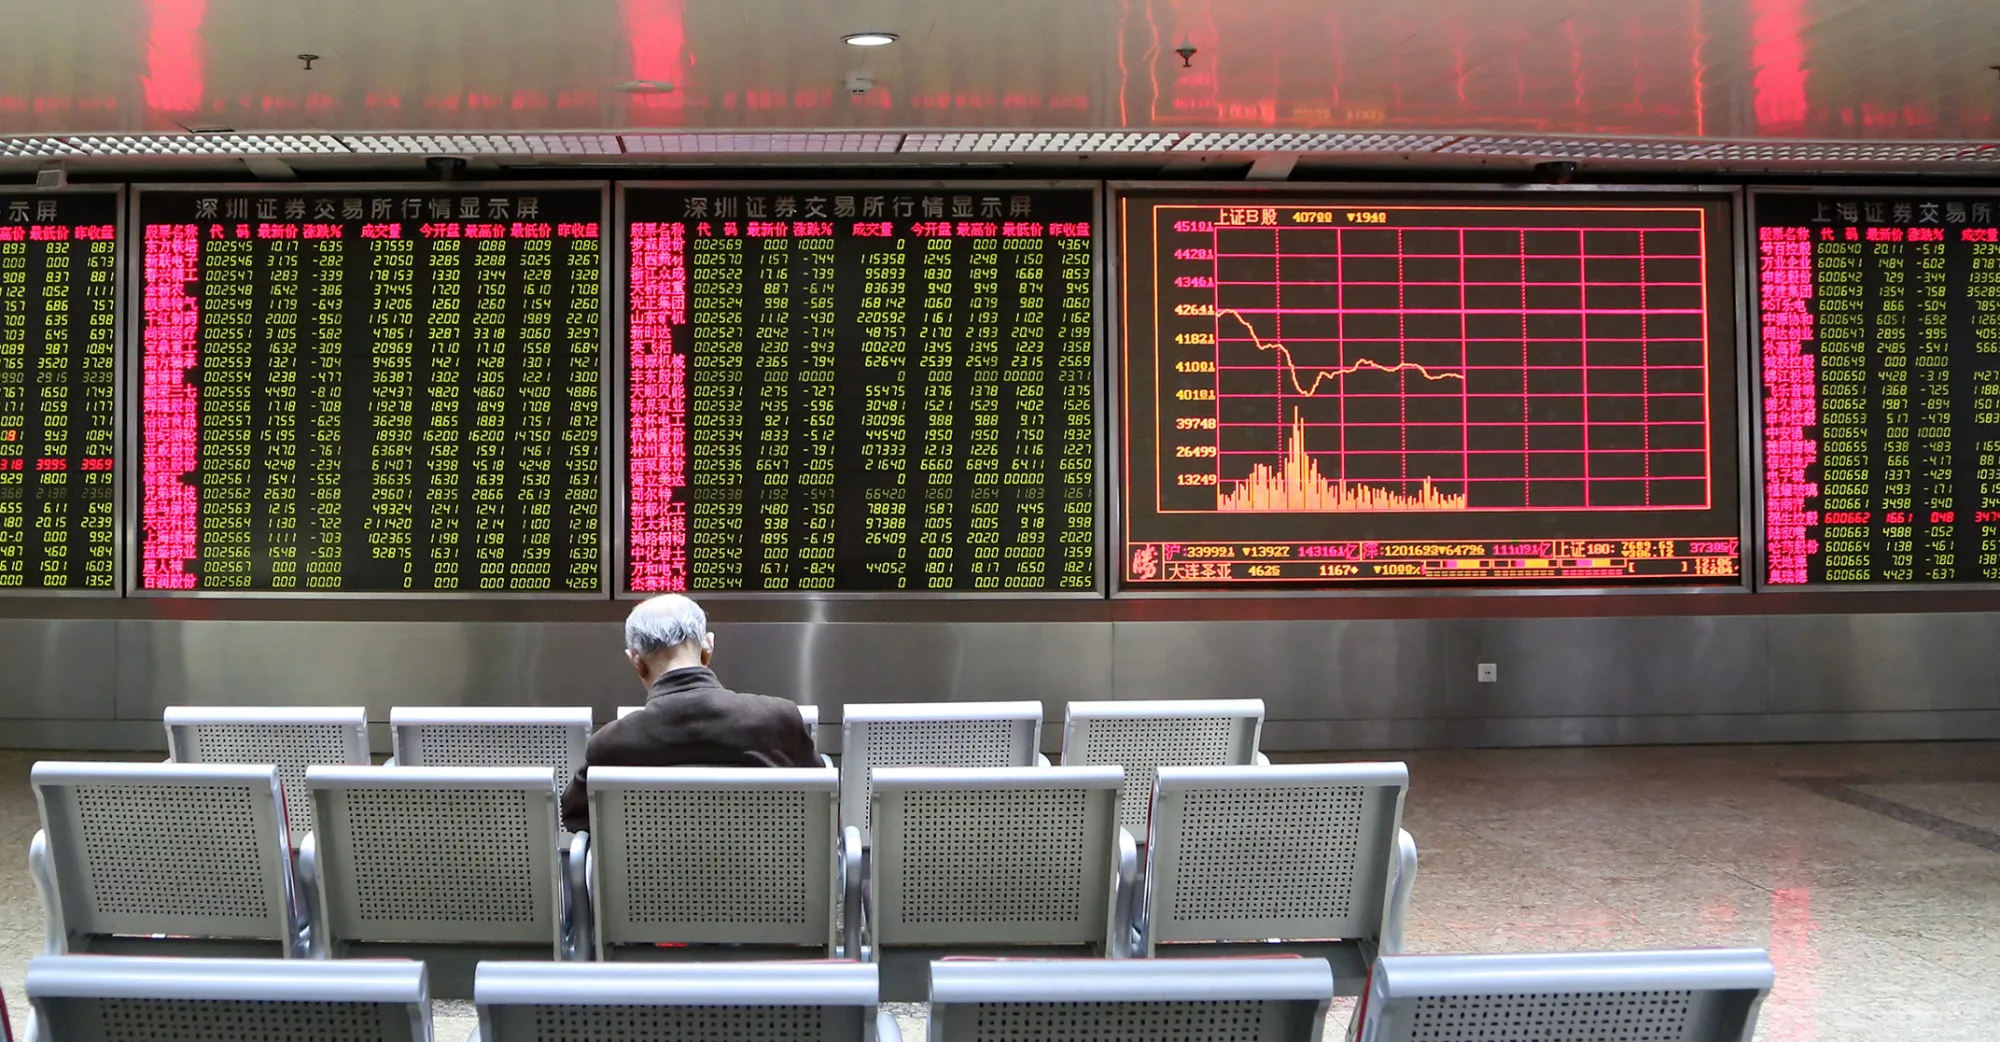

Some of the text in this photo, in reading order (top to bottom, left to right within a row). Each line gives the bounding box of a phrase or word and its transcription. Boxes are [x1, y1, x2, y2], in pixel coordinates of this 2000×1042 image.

[0, 201, 58, 221] 示屏
[195, 198, 540, 220] 深圳证券交易所行情显示屏
[683, 196, 1032, 218] 深圳证券交易所行情显示屏
[1812, 202, 2000, 223] 上海证券交易所
[0, 225, 114, 241] 高价 最低价 昨收盘
[145, 223, 599, 239] 股票名称 代码 最新价 涨跌% 成交量 今开盘 最高价 最低价 昨收盘
[630, 222, 1090, 238] 股票名称 代码 最新价 涨跌% 成交量 今开盘 最高价 最低价 昨收盘
[1759, 227, 1998, 242] 股票名称 代码 最新价 涨跌% 成交量
[1169, 563, 1232, 579] 大连圣亚
